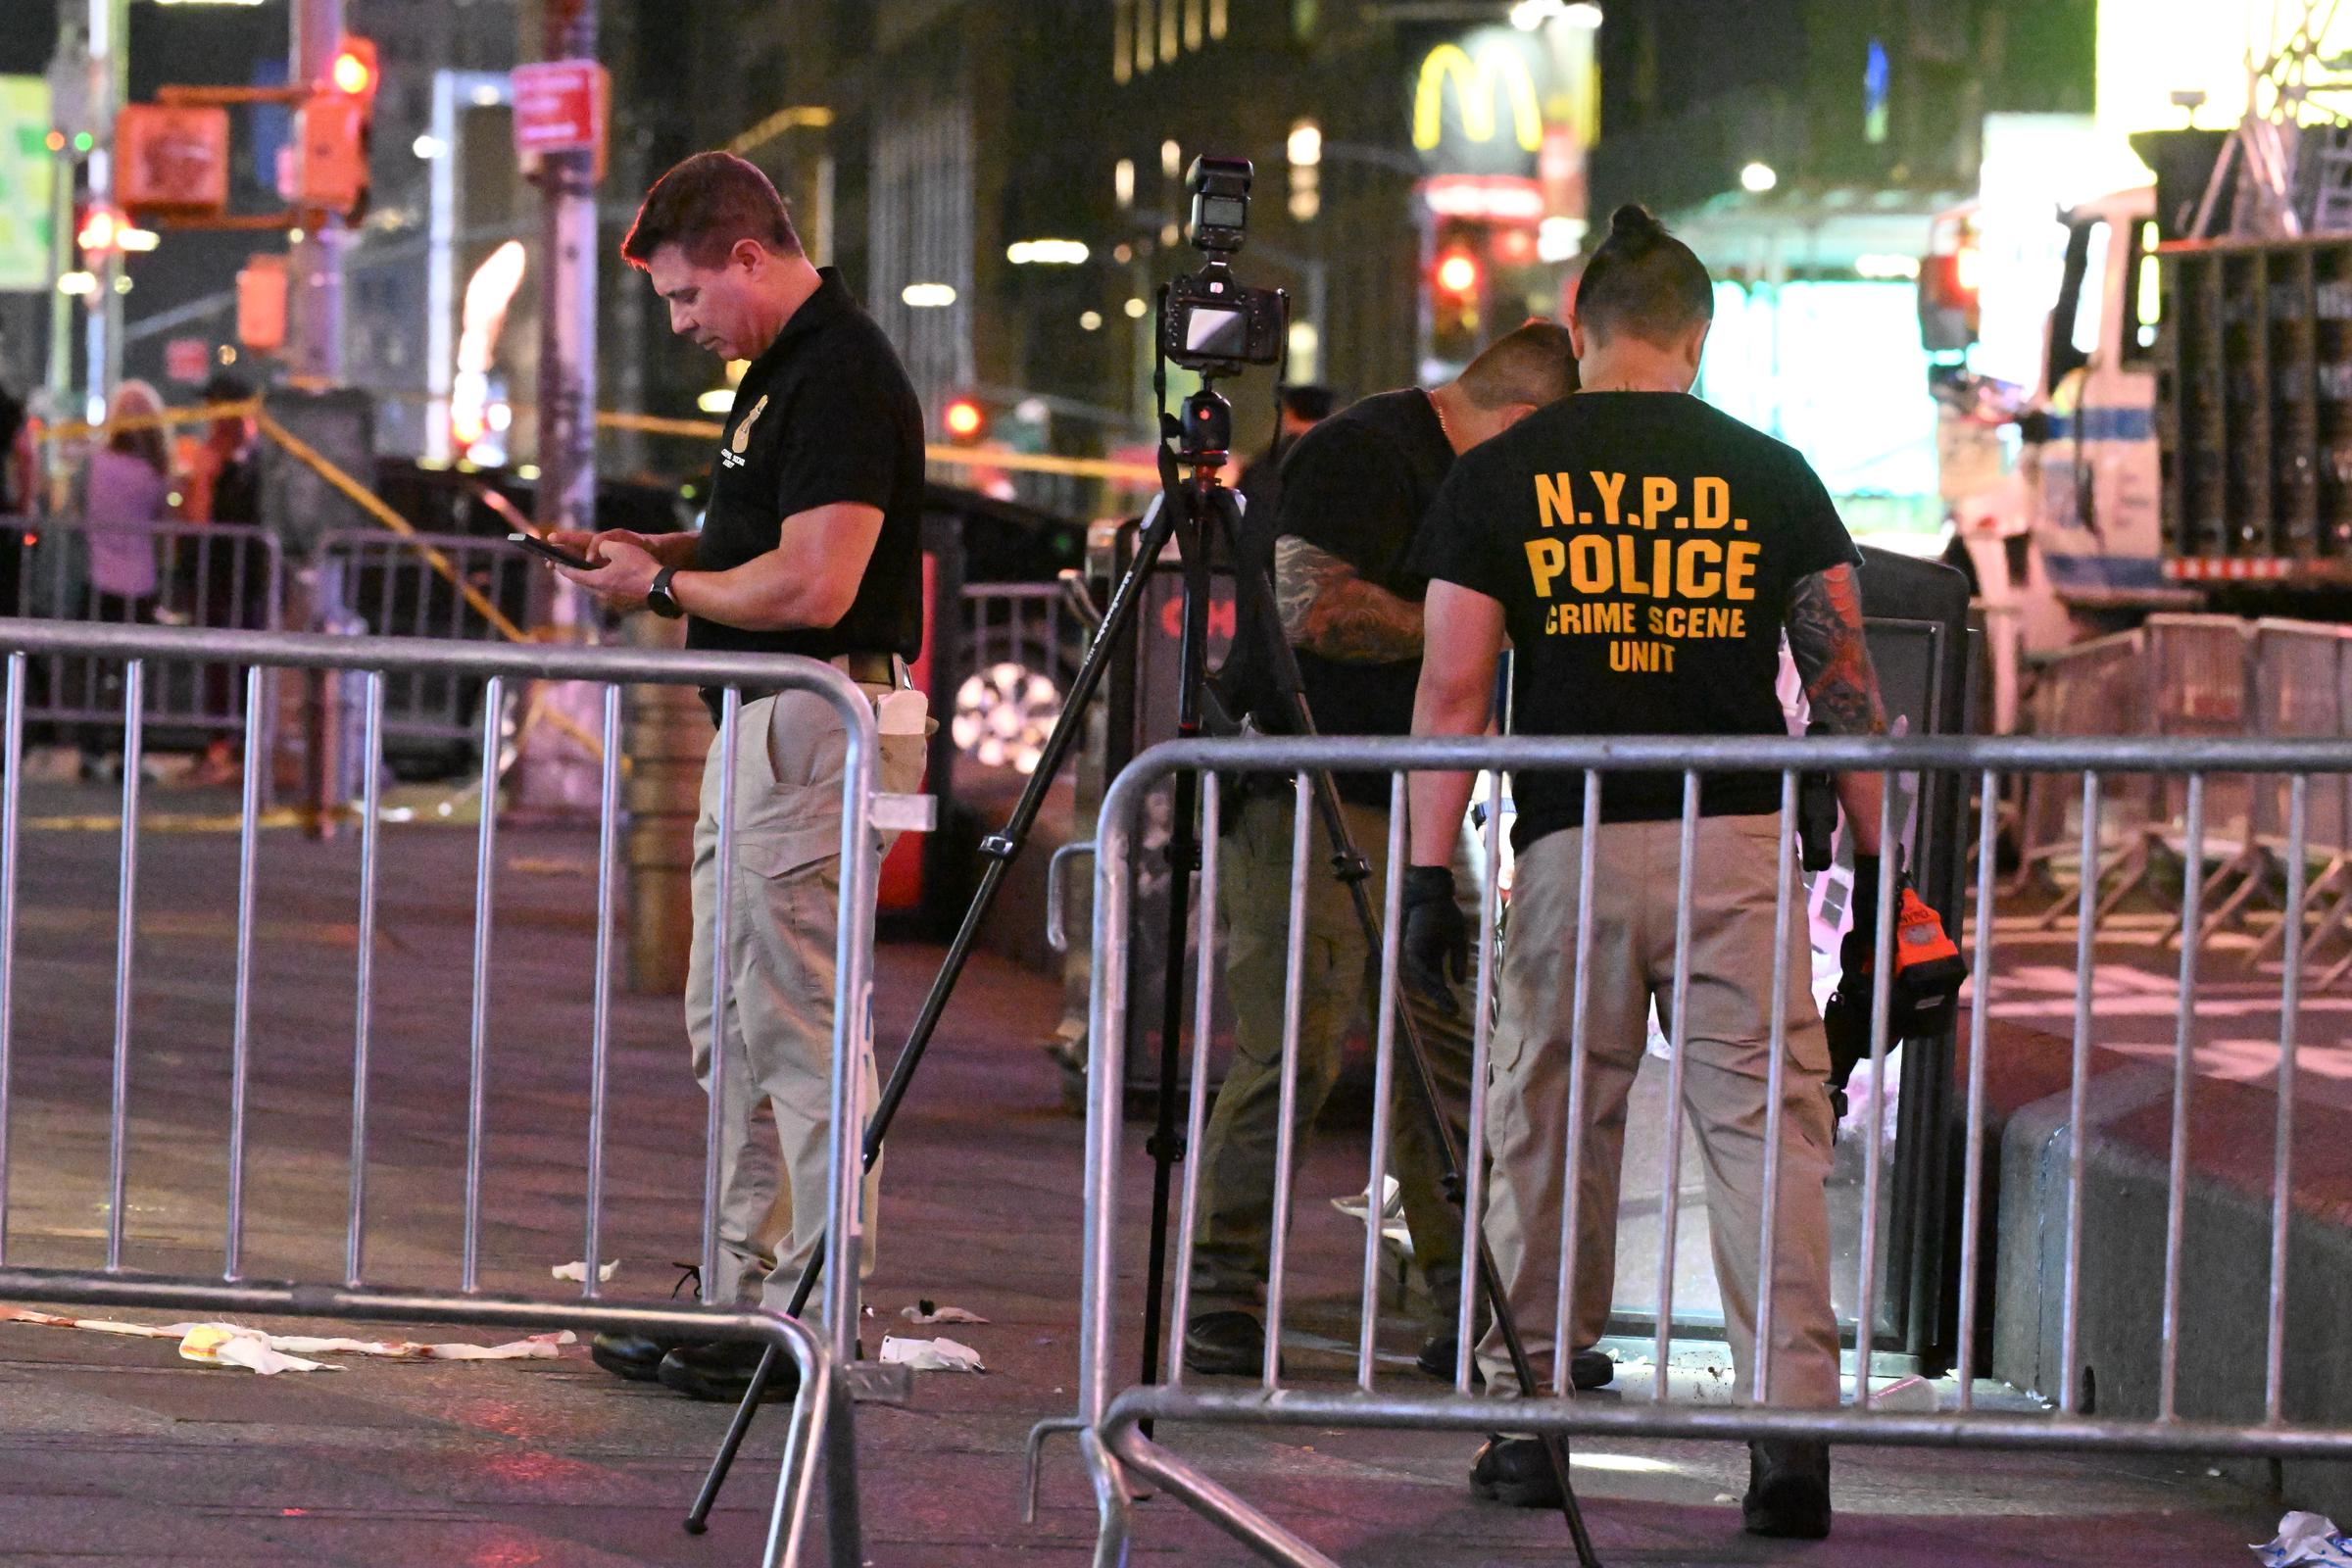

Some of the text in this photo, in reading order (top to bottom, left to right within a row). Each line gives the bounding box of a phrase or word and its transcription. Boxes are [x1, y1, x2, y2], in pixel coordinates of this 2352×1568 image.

[1534, 470, 1748, 531] N.Y.P.D.
[1524, 534, 1761, 600] POLICE
[1545, 603, 1745, 638] CRIME SCENE
[1610, 641, 1676, 673] UNIT
